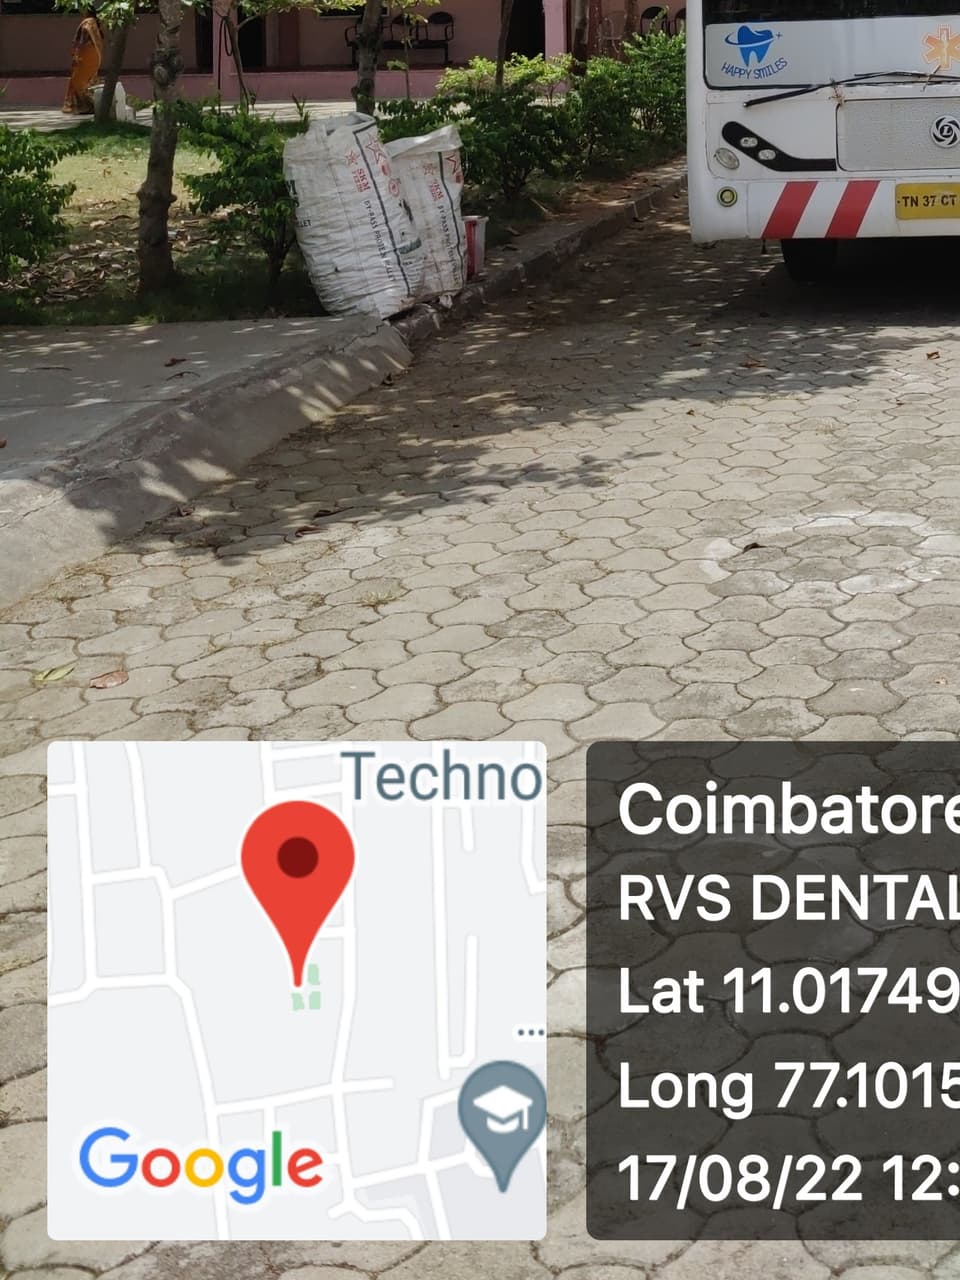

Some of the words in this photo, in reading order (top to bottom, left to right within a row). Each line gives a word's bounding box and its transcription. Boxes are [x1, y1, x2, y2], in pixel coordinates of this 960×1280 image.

[721, 61, 752, 79] HAPPY
[753, 57, 788, 80] SMILES
[356, 168, 371, 191] SKM
[902, 195, 919, 207] TN
[922, 195, 936, 207] 37
[941, 194, 957, 206] CT
[363, 200, 378, 229] BY-PASS
